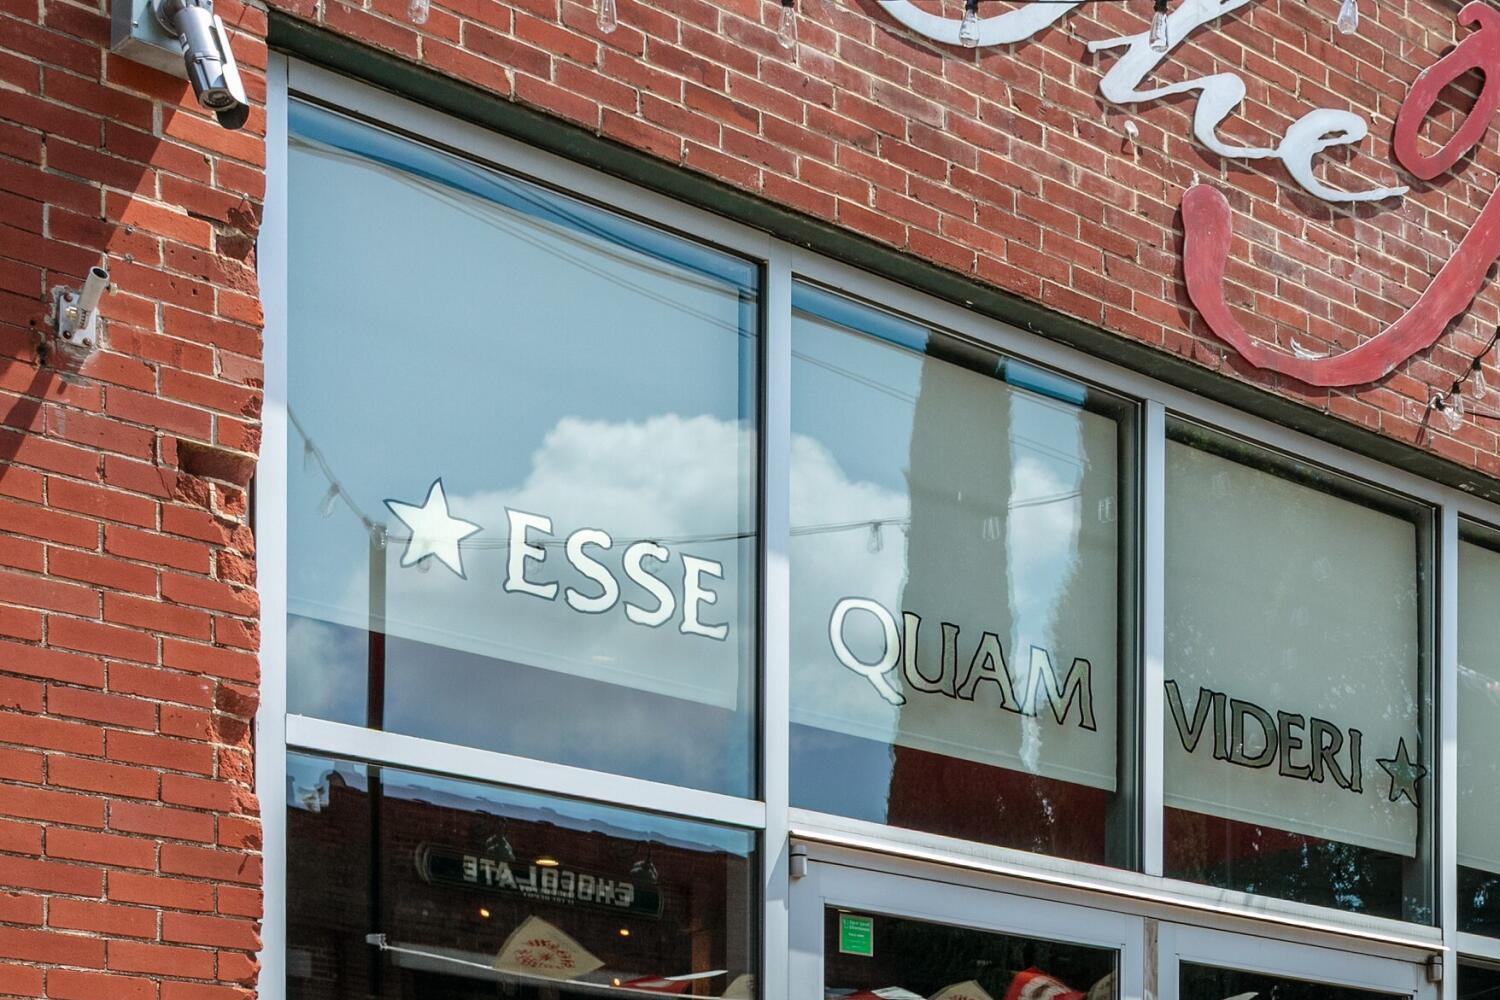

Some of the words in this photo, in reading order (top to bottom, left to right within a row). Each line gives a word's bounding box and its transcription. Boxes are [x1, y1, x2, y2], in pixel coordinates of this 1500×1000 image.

[503, 506, 730, 641] ESSE
[828, 597, 1097, 731] QUAM
[1164, 679, 1363, 793] VIDERI
